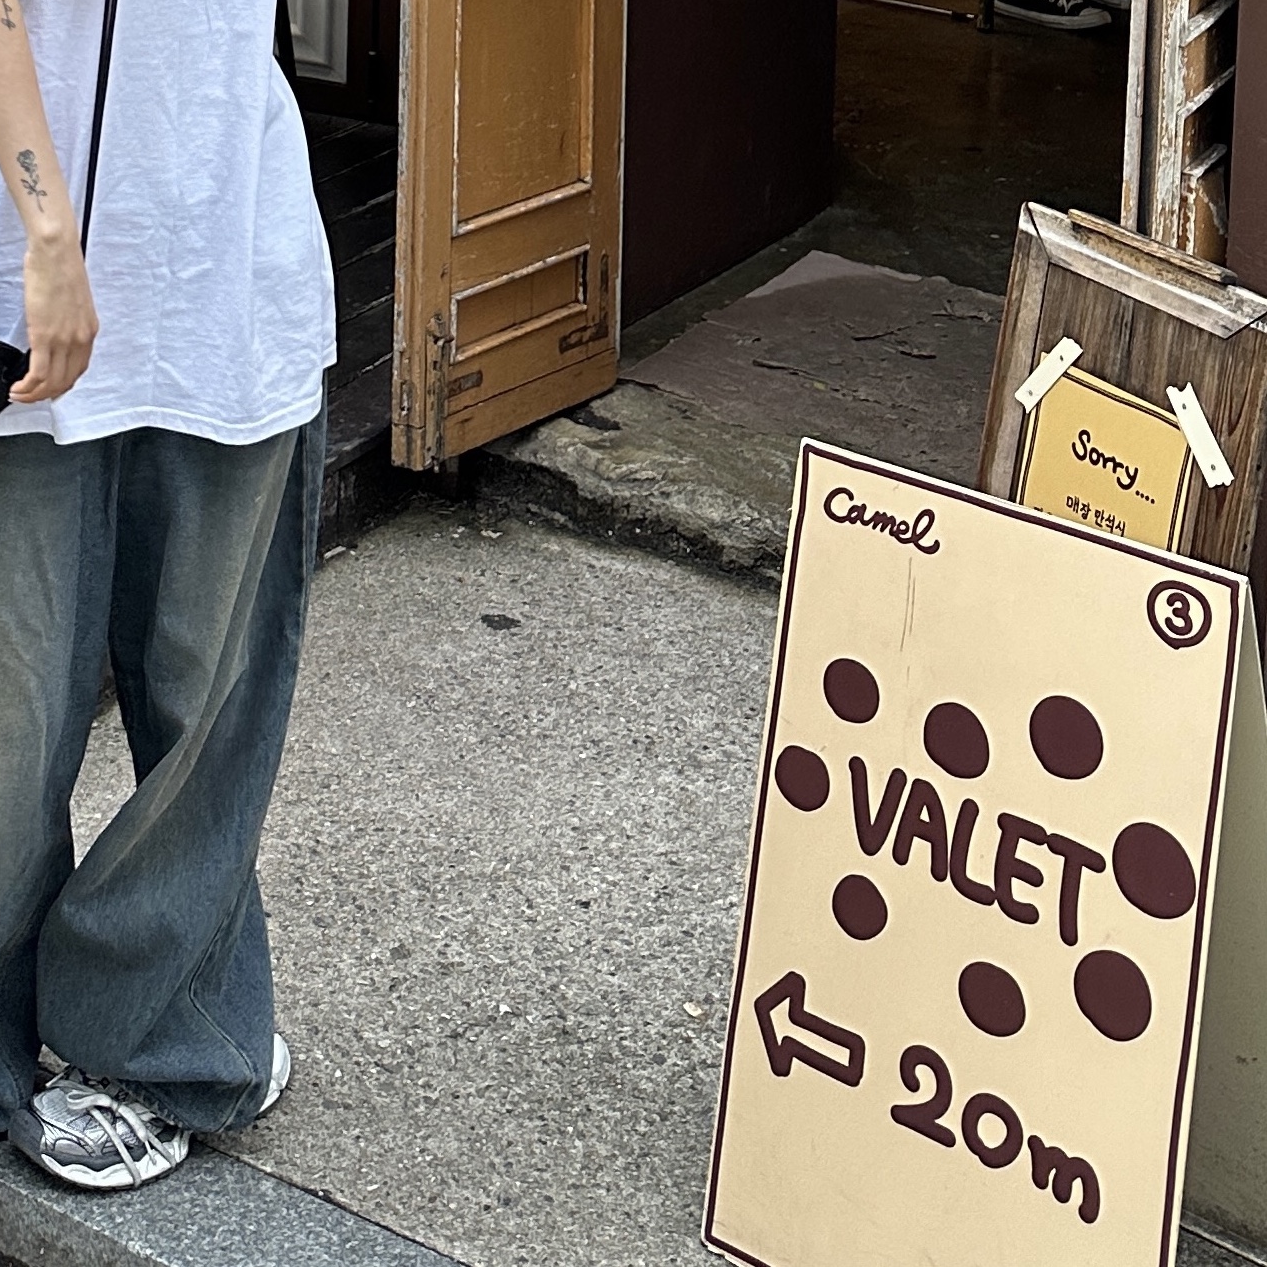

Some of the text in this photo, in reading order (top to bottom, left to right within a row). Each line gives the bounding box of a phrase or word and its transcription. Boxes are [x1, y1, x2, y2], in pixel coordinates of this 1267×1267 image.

[823, 487, 941, 555] Camel
[1066, 496, 1092, 520] 매장
[848, 755, 1107, 947] VALET
[890, 1044, 1101, 1225] 20m
